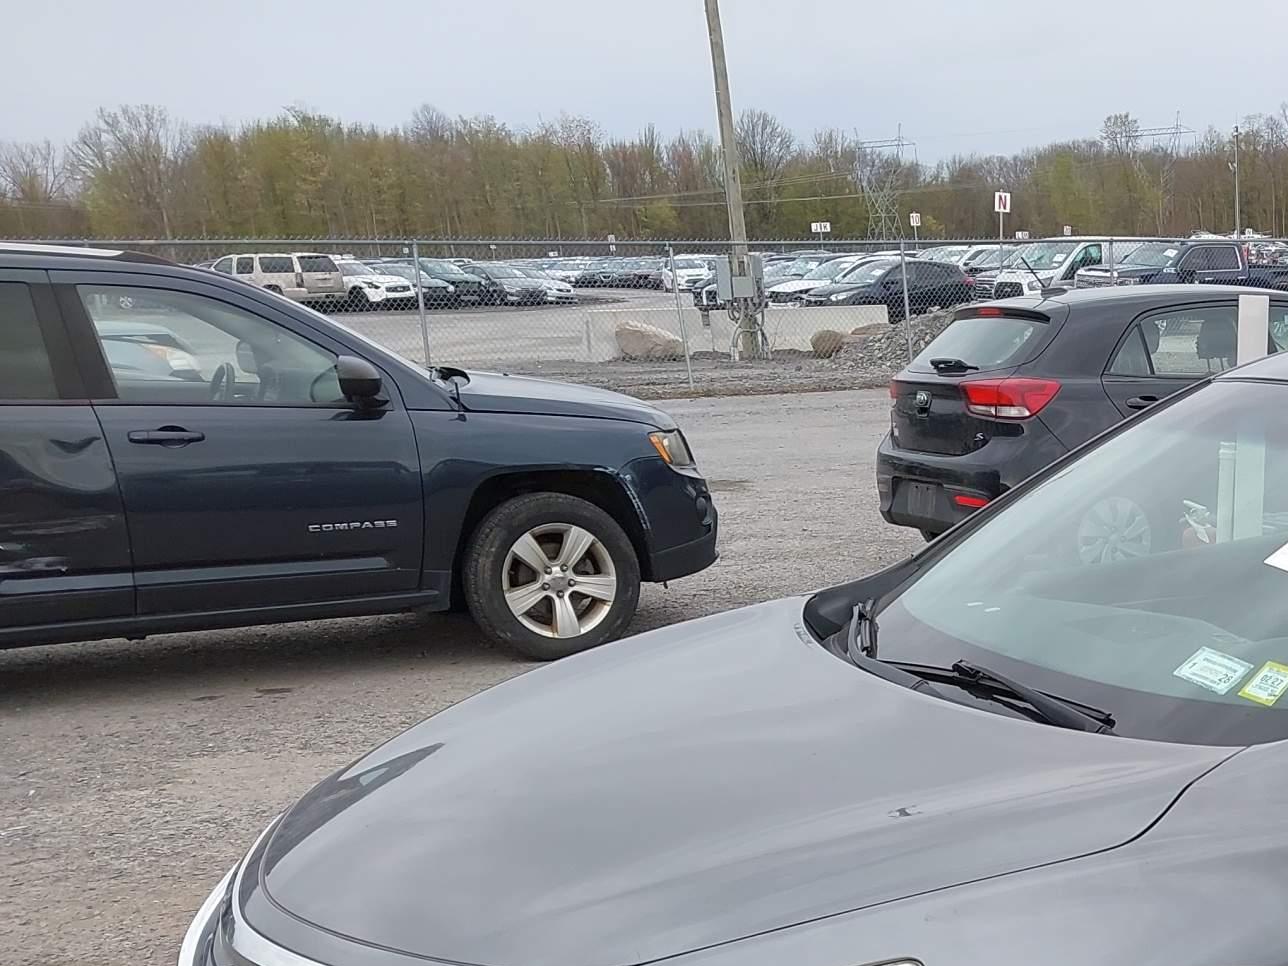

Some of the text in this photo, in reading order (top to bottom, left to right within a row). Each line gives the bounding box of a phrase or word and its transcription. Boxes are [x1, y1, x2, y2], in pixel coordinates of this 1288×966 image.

[999, 195, 1007, 209] N
[911, 214, 919, 224] 10
[308, 520, 398, 531] COMPASS
[1218, 673, 1234, 684] 28
